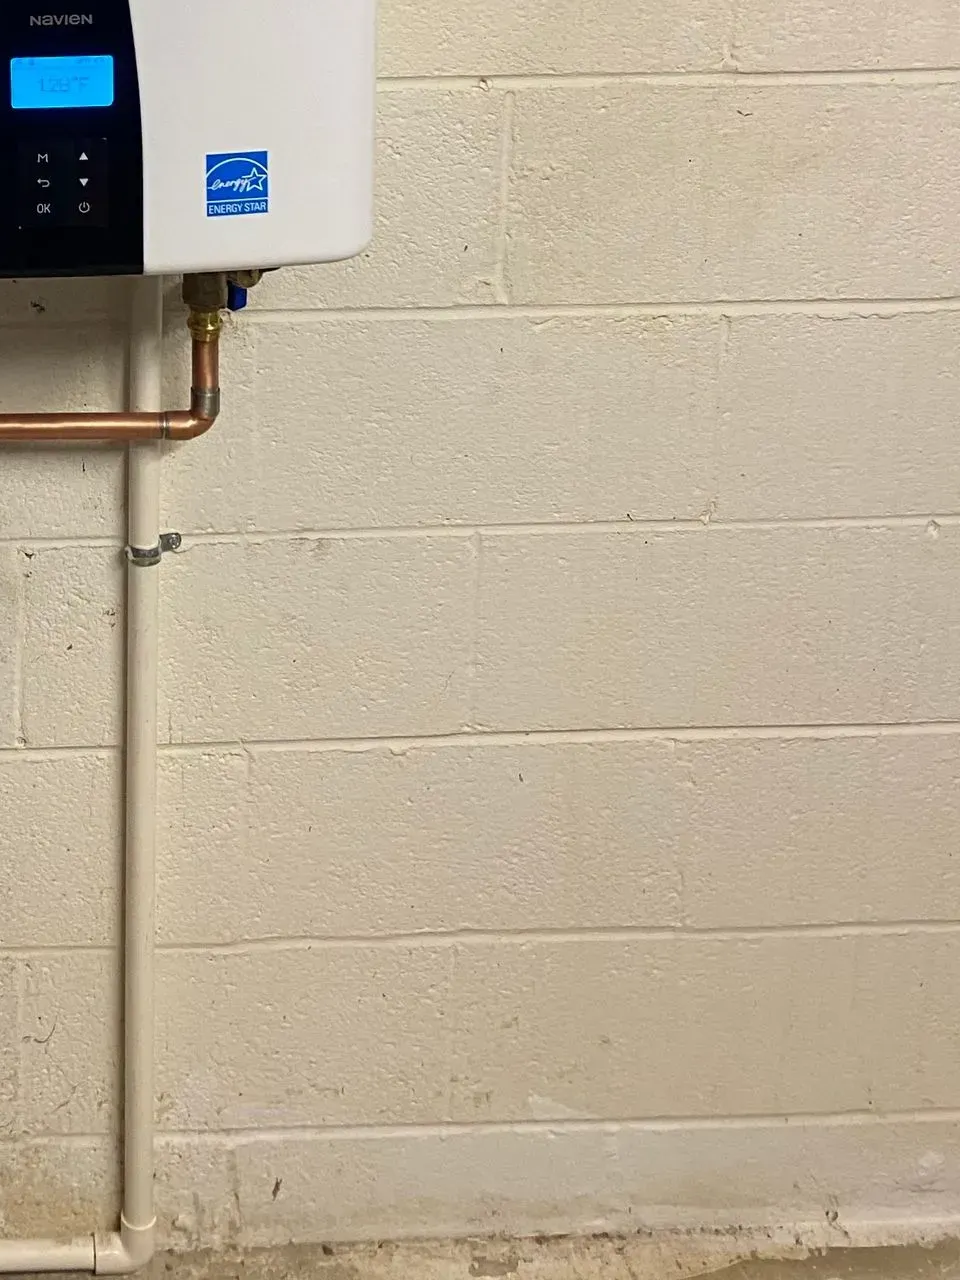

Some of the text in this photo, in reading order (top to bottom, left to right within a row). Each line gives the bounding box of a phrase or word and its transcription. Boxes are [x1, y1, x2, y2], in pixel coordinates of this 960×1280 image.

[37, 153, 49, 163] M
[36, 203, 51, 214] OK
[208, 201, 266, 215] ENERGY STAR
